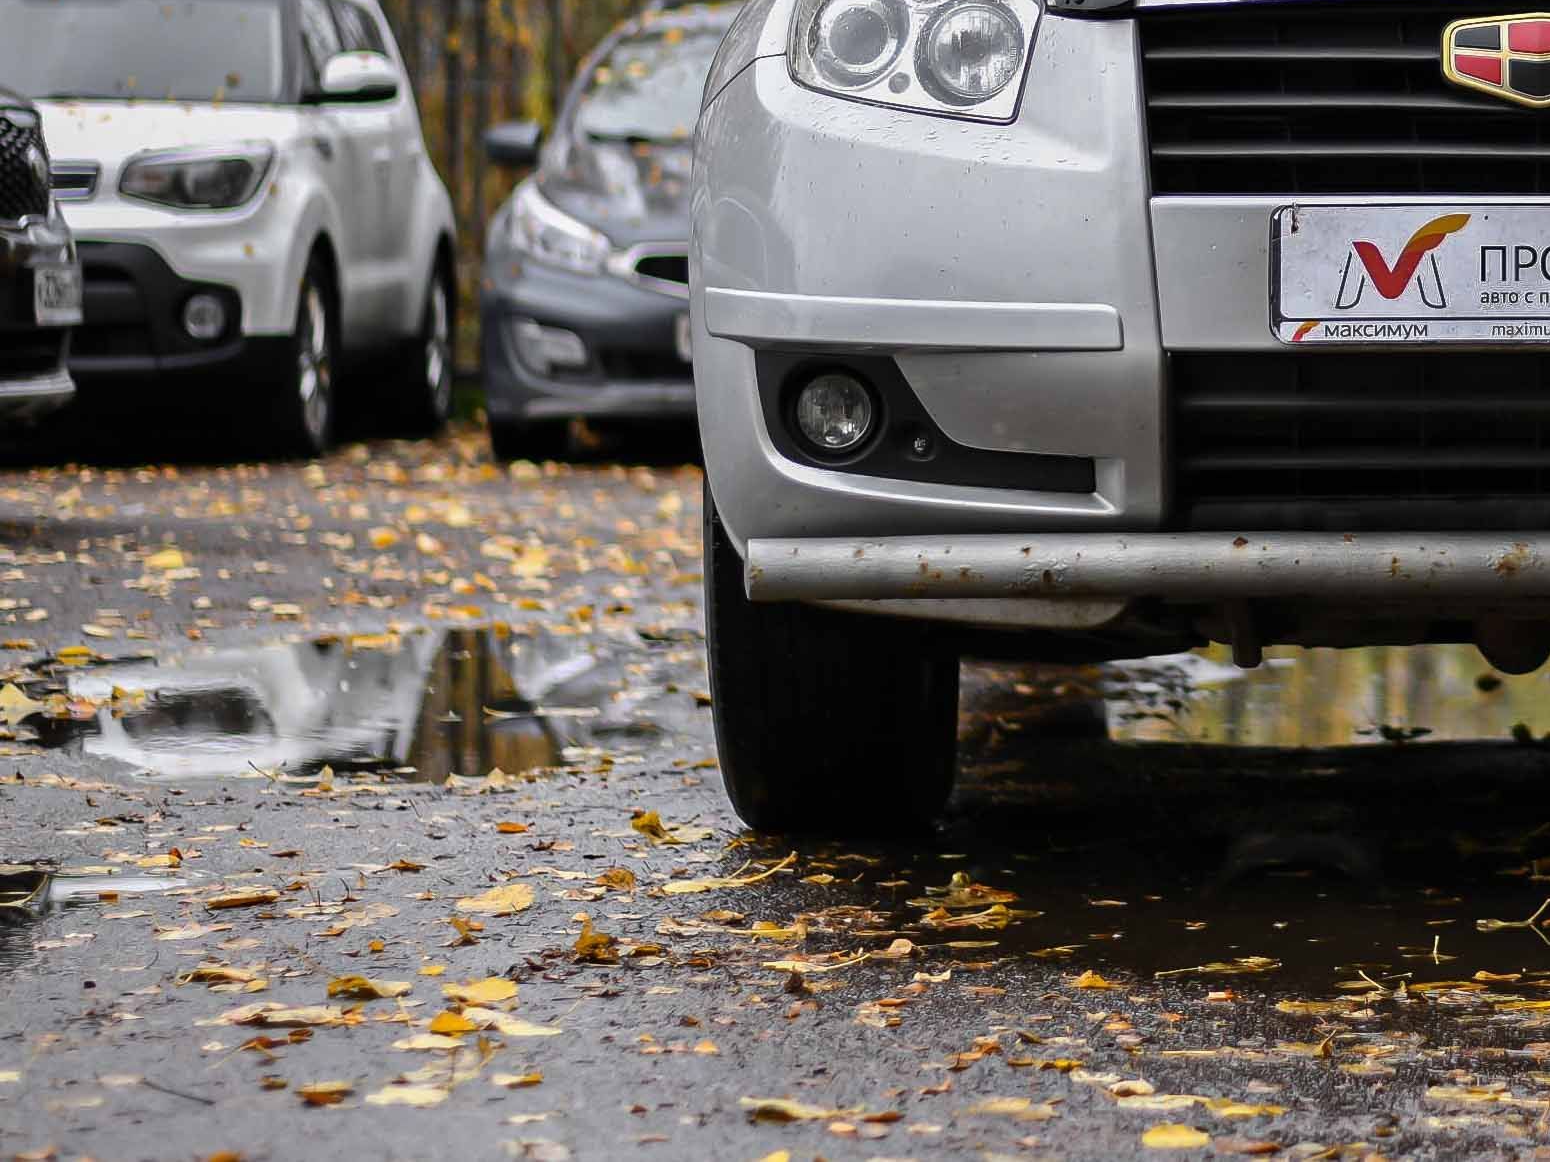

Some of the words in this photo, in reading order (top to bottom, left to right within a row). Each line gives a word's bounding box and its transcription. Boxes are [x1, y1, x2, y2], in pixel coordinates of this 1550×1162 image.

[1479, 290, 1520, 305] авто
[1524, 290, 1534, 305] с
[1324, 323, 1429, 340] максимум
